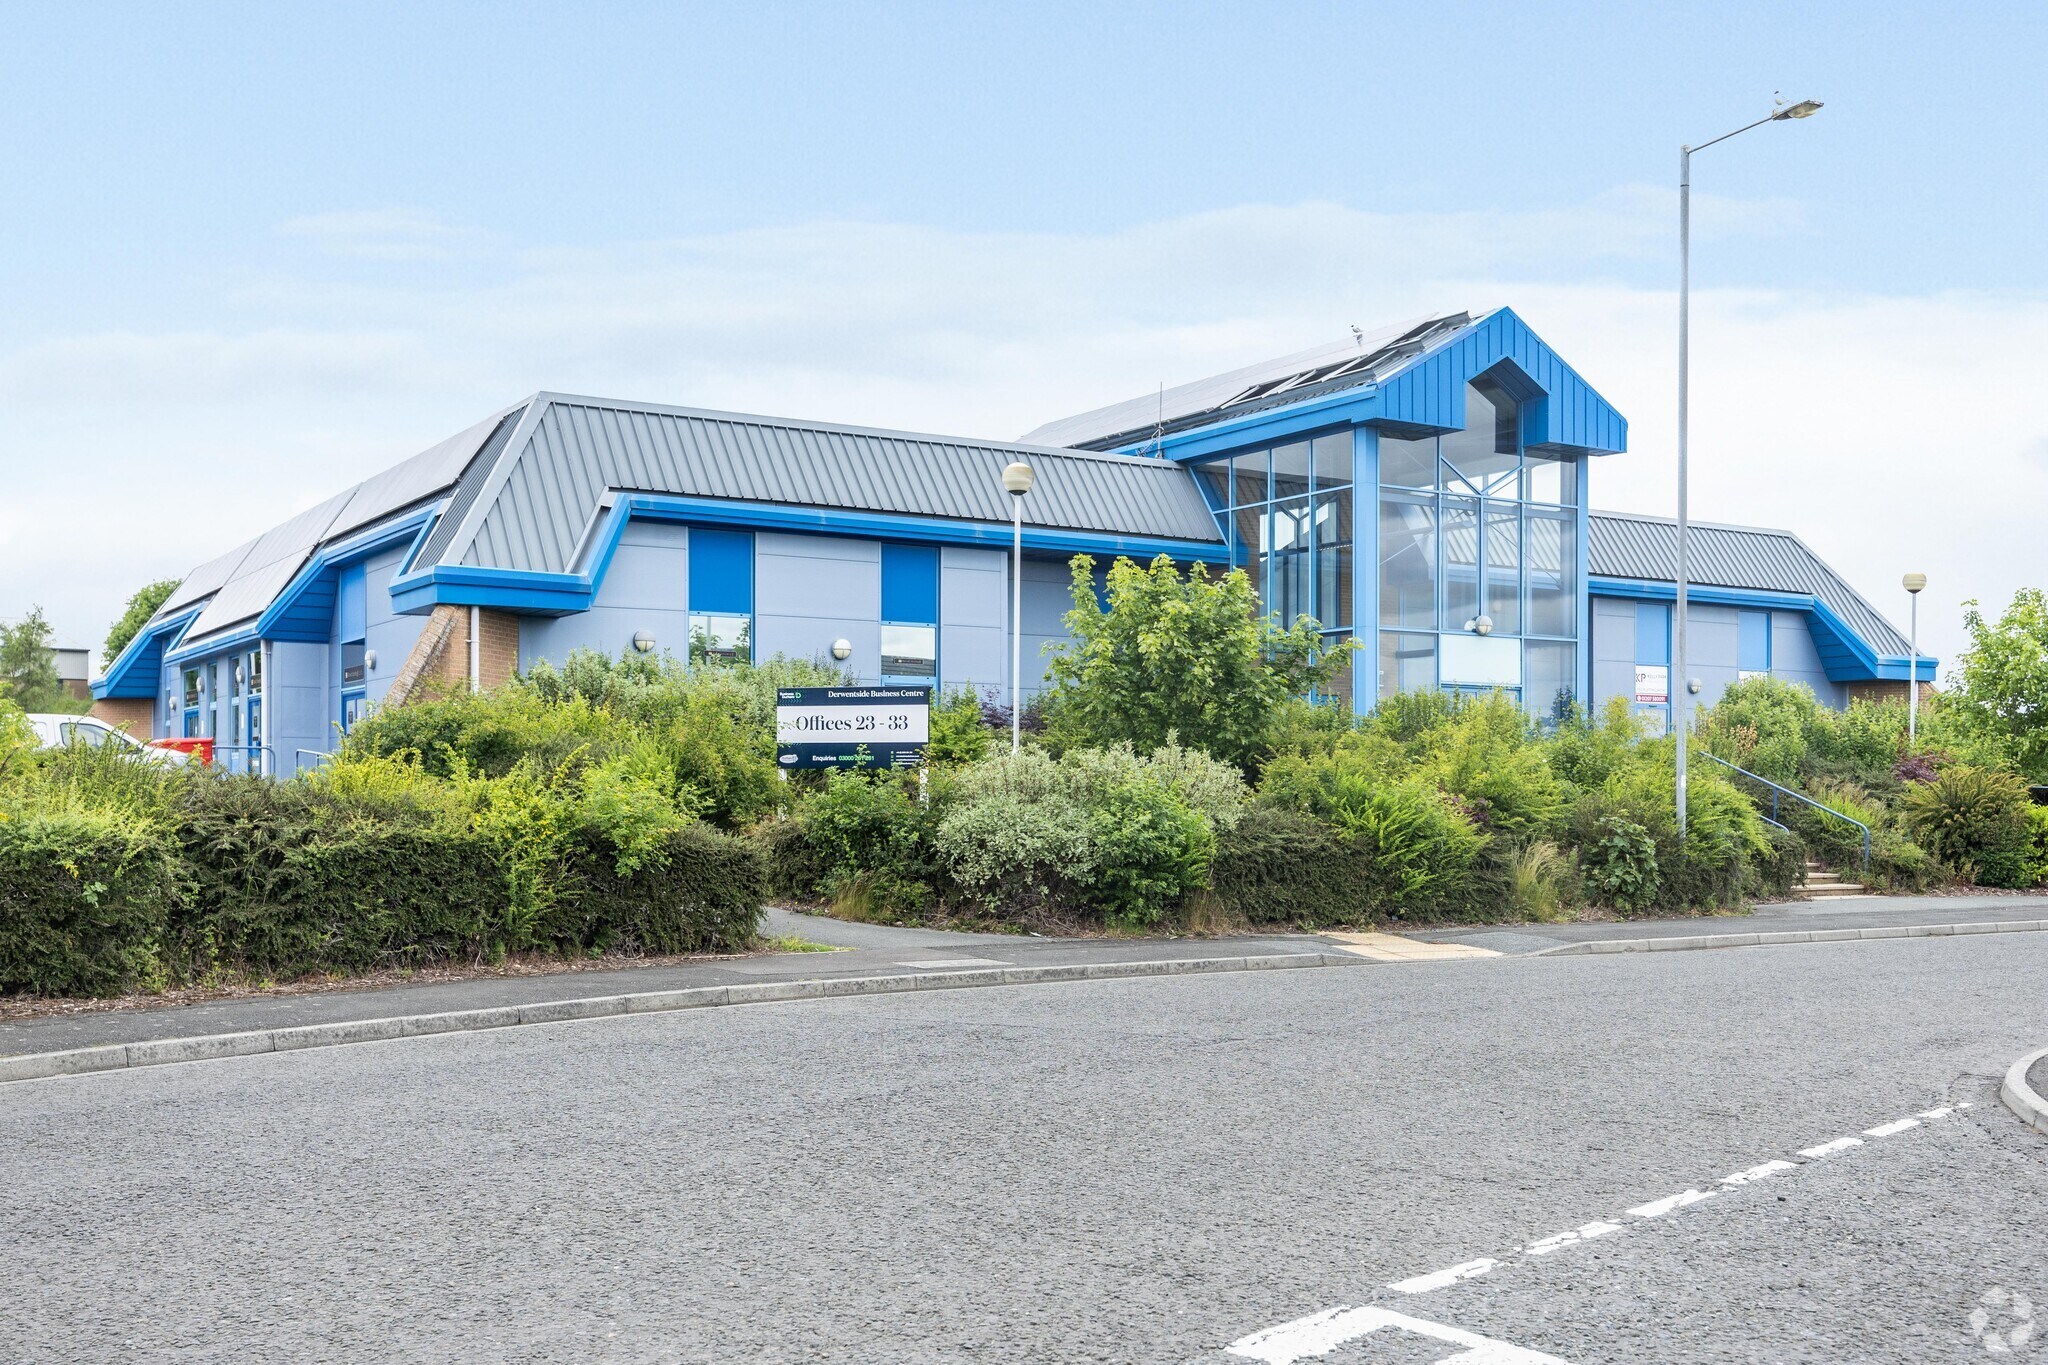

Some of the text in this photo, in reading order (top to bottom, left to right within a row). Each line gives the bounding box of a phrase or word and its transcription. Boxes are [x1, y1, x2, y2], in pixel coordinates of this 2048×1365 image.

[796, 715, 852, 730] Offices
[856, 715, 876, 730] 23
[888, 714, 908, 730] 33
